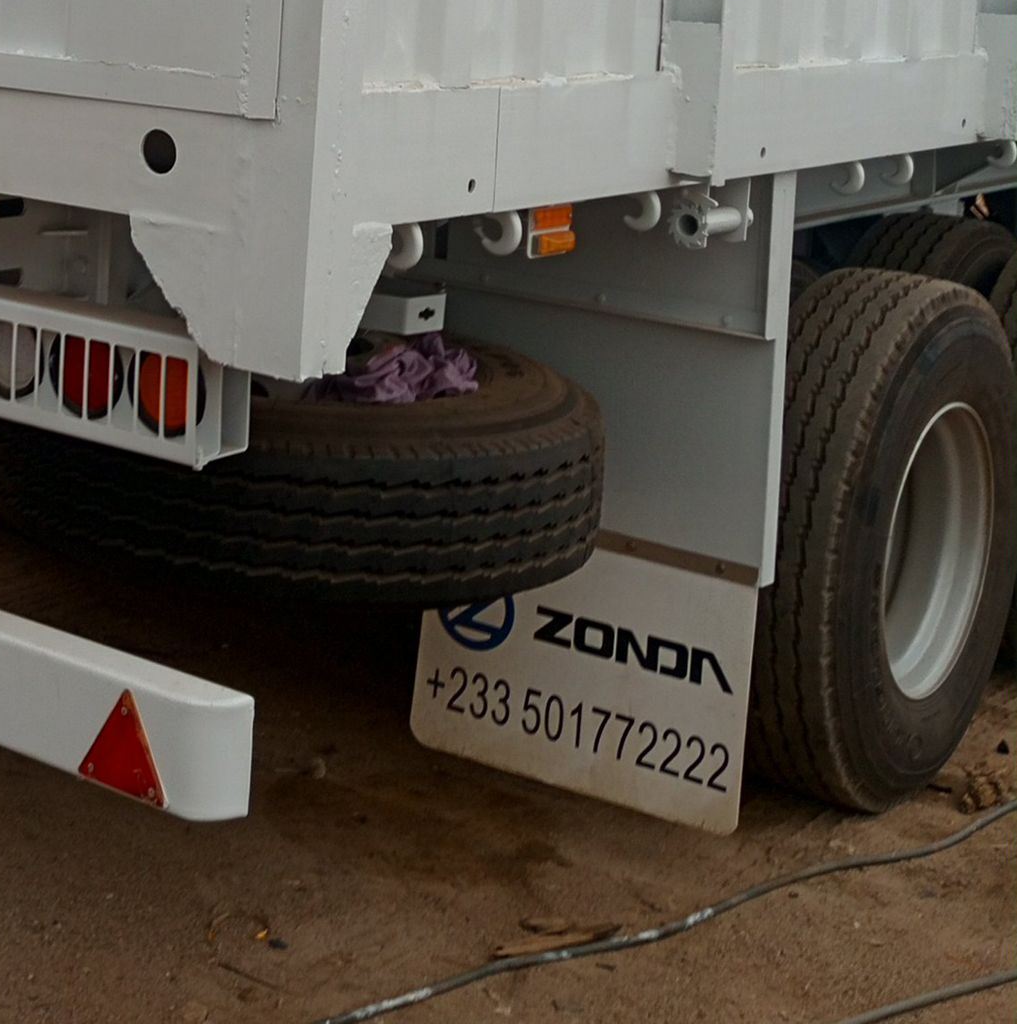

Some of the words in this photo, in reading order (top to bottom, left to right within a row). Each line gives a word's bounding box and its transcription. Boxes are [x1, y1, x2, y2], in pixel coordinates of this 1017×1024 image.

[533, 604, 734, 696] ZONDA
[425, 666, 511, 727] +233
[521, 687, 731, 793] 501772222
